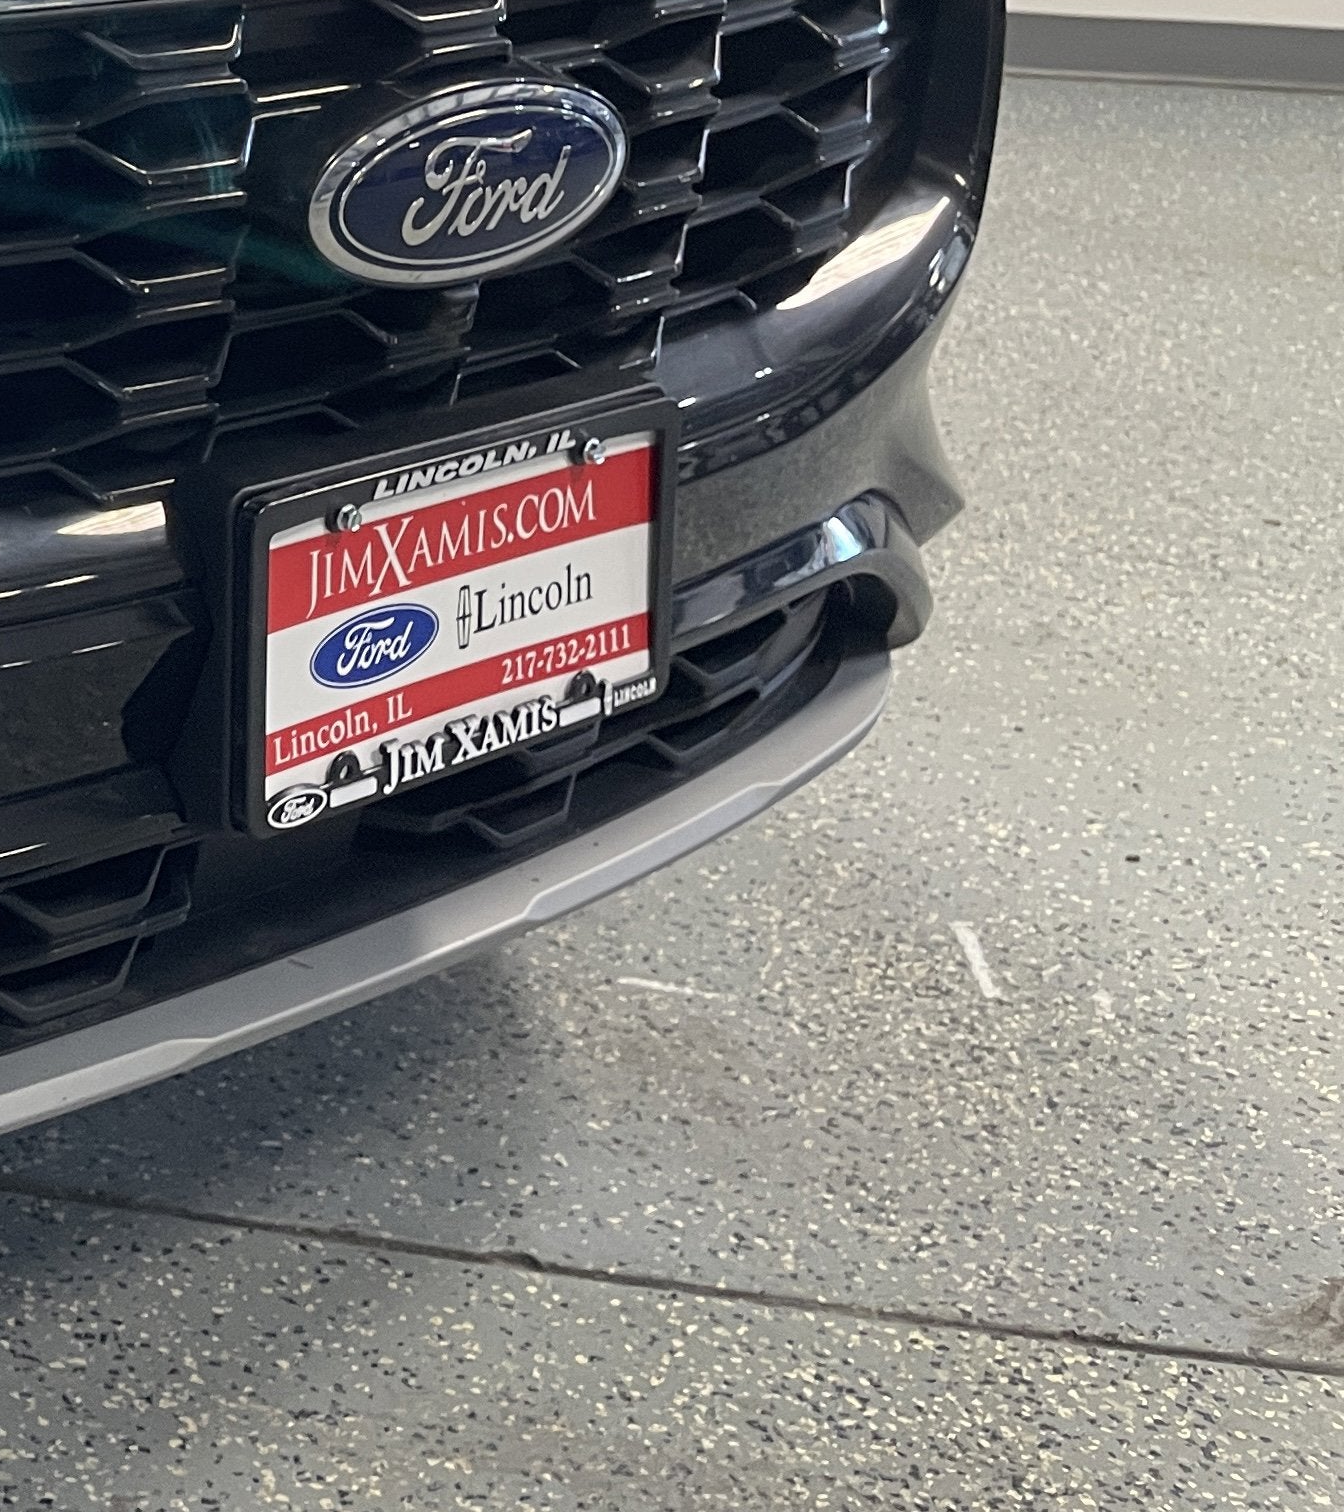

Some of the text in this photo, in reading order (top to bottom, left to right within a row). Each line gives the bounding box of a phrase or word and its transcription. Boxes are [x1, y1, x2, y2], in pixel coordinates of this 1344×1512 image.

[402, 128, 572, 246] Ford
[373, 430, 576, 501] LINCOLN, IL
[306, 480, 597, 619] JIMXAMIS.COM
[473, 563, 593, 634] Lincoln
[337, 617, 414, 676] Ford
[501, 624, 631, 685] 217-732-2111
[273, 692, 413, 766] Lincoln, IL
[383, 697, 558, 795] JIM XAMIS
[280, 796, 315, 823] Ford
